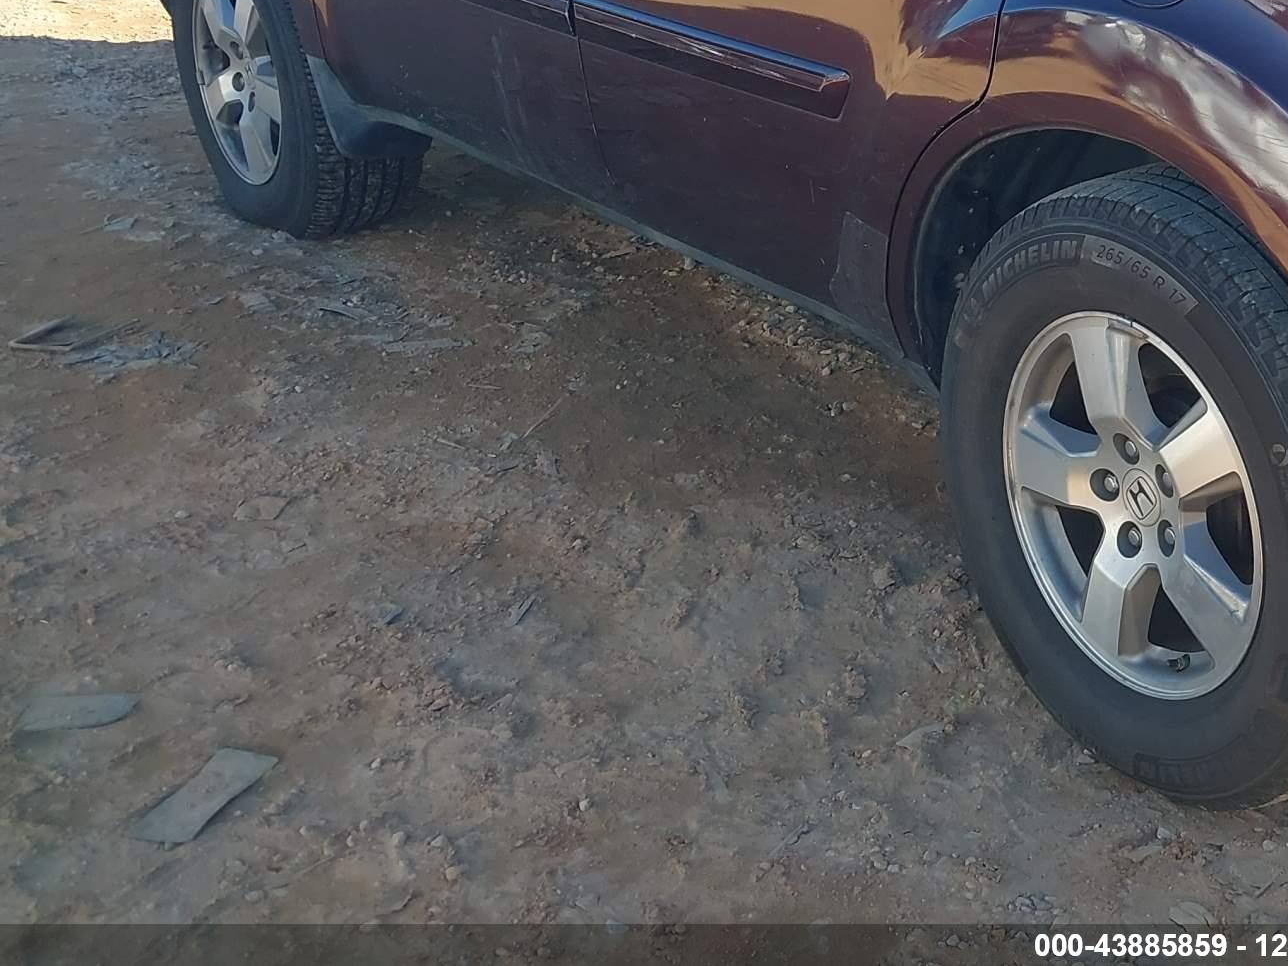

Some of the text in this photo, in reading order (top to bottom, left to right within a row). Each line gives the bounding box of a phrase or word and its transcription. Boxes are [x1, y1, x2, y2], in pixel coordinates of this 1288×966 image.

[982, 240, 1187, 305] MICHELIN 265/65 R 17
